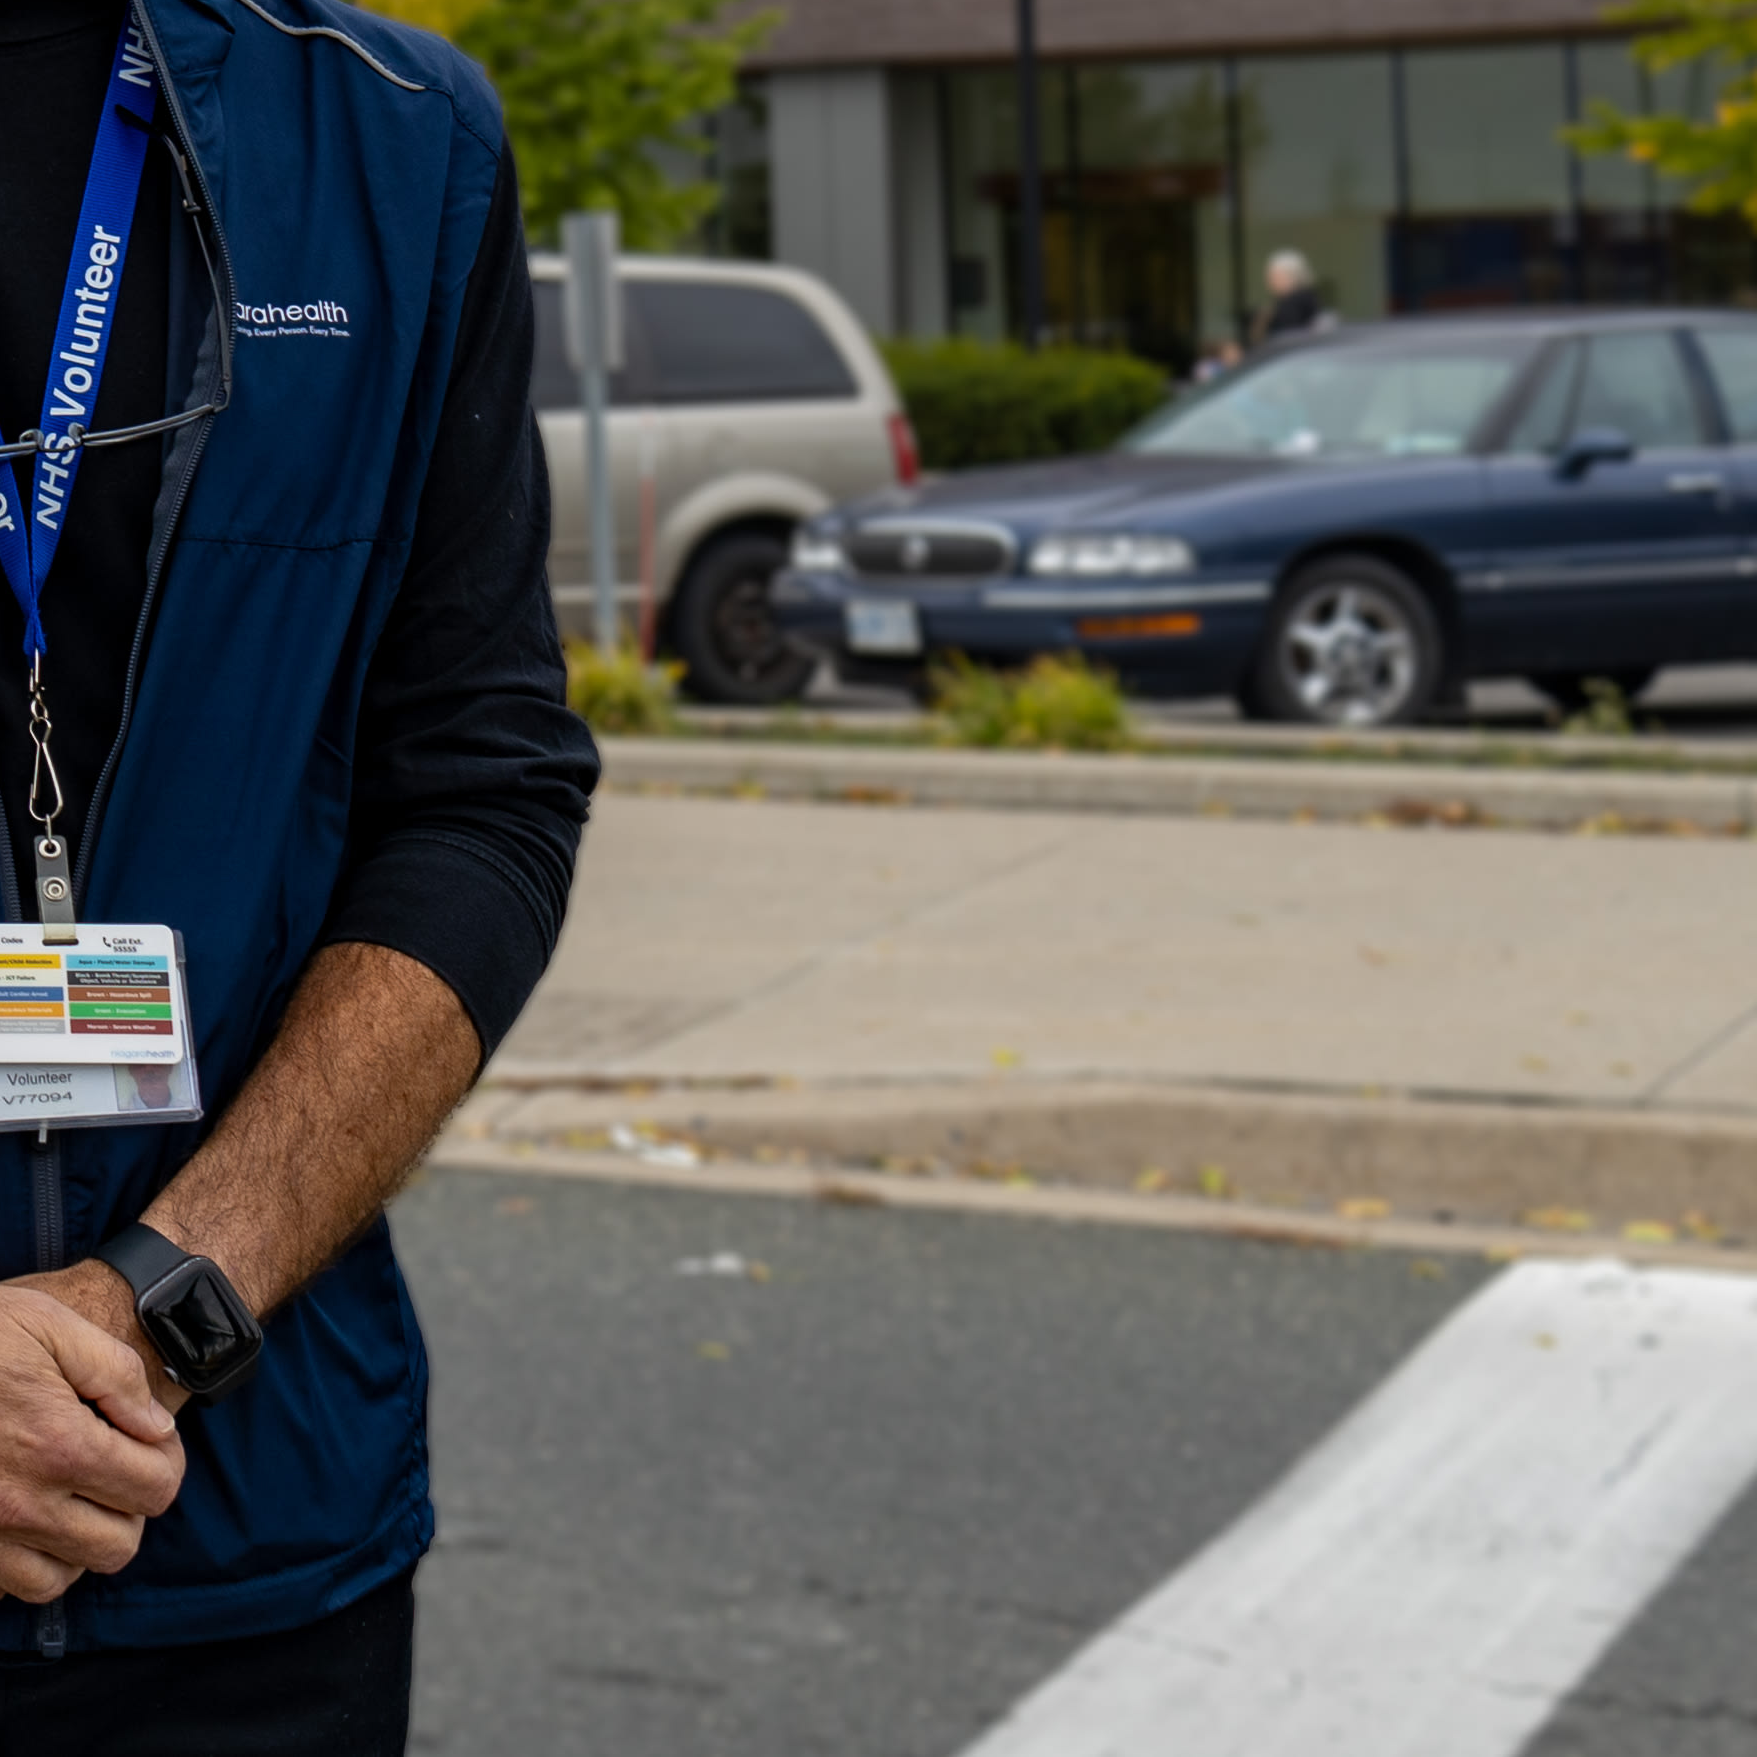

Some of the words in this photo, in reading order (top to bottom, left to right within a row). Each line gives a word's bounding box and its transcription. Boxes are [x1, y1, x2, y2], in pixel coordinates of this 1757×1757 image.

[49, 224, 121, 417] Volunteer
[36, 432, 77, 531] NHS
[110, 1050, 175, 1059] niagarahealth
[6, 1072, 72, 1086] Volunteer
[1, 1091, 73, 1105] V77094
